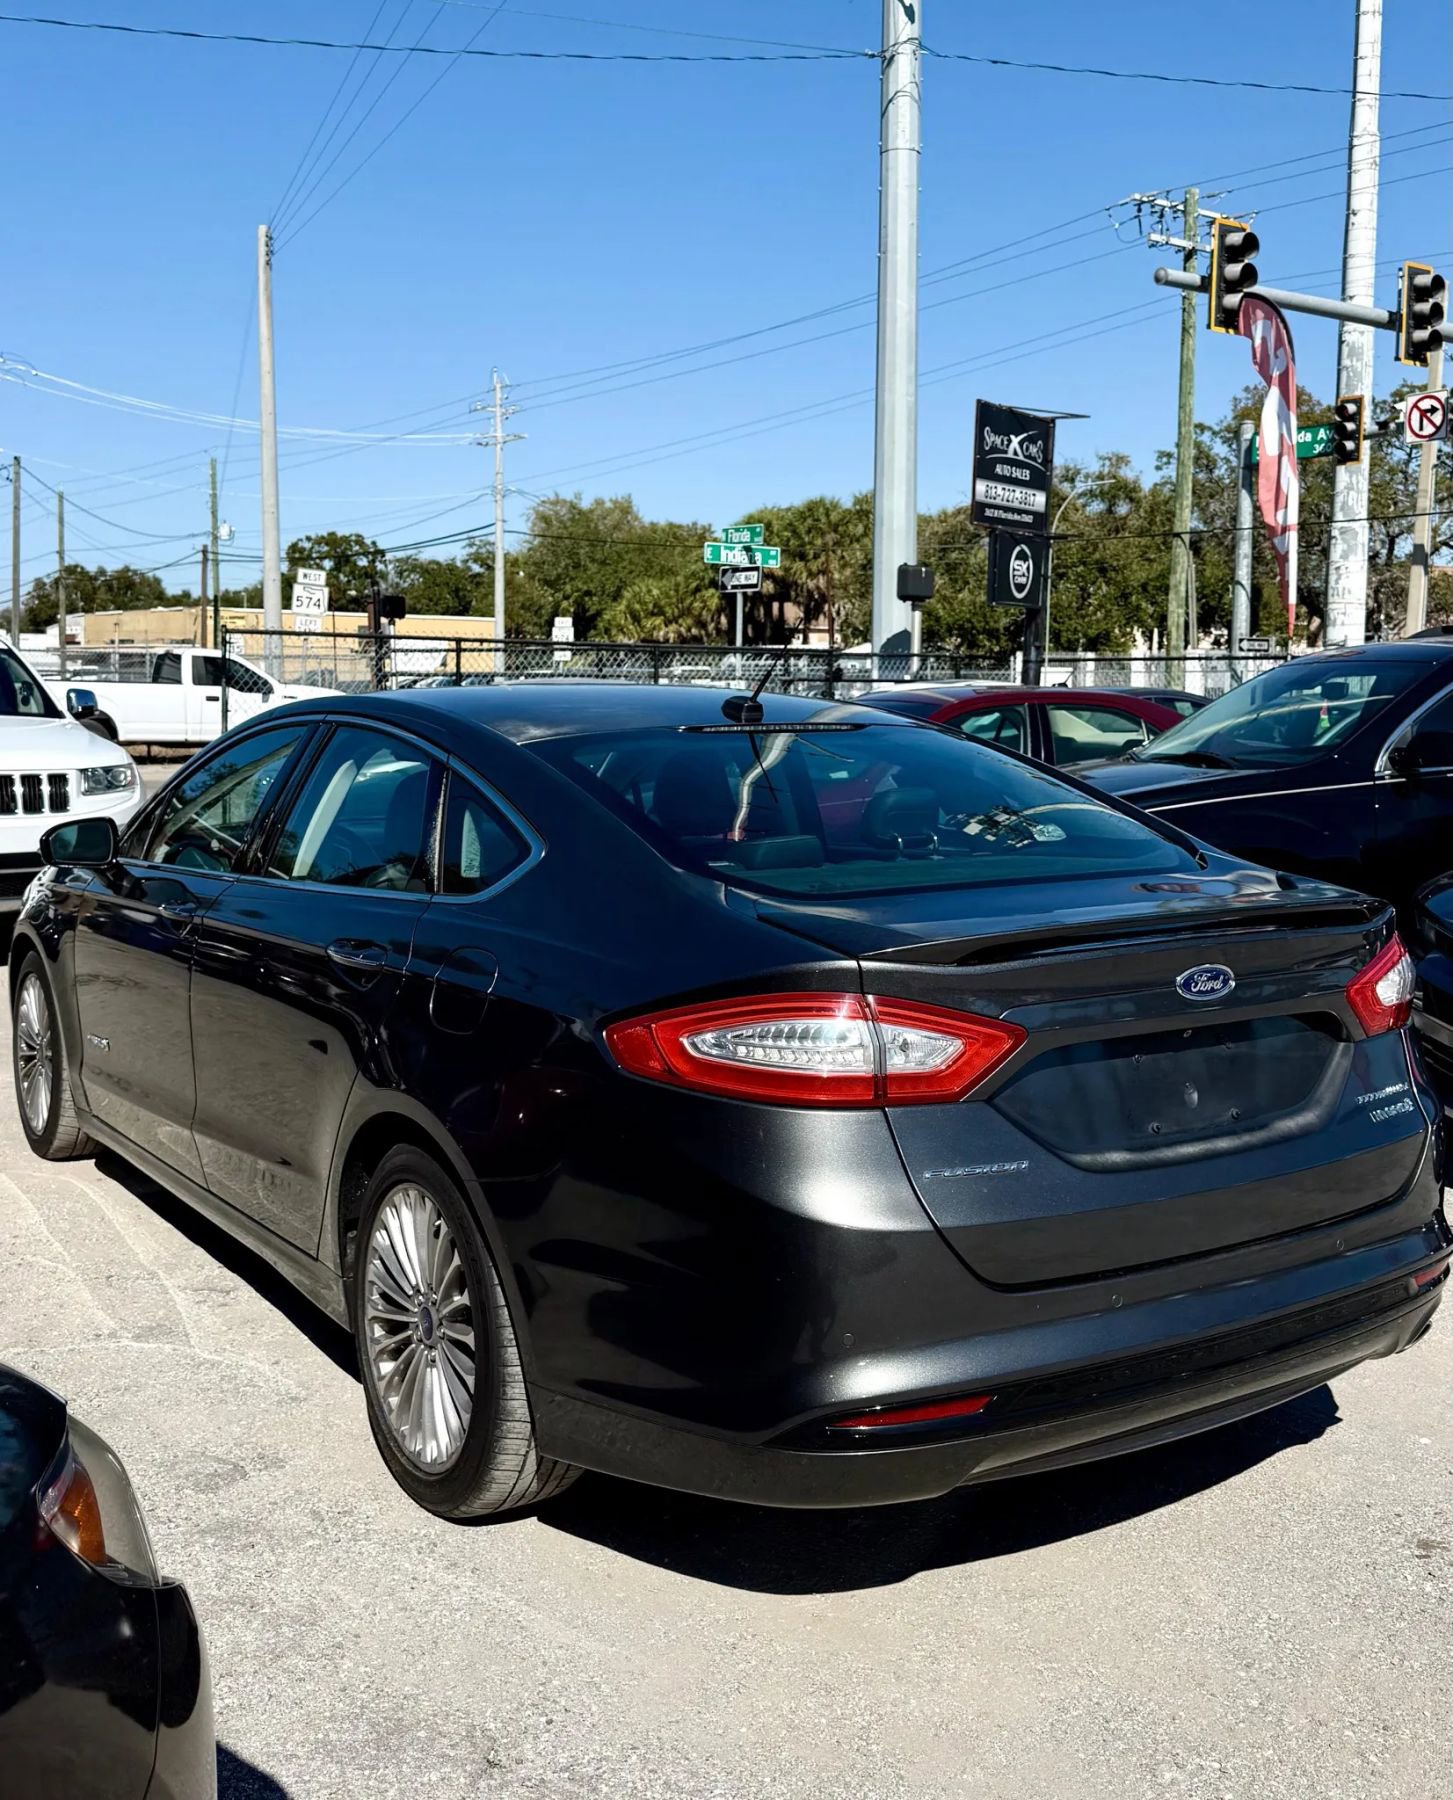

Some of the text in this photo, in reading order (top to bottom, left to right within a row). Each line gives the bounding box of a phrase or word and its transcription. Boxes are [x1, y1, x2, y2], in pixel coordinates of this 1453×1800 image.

[984, 426, 1009, 451] SPACE
[1023, 440, 1044, 463] CARS
[994, 464, 1030, 481] AUTO SALES
[984, 483, 1038, 508] 813-727-3817
[728, 529, 751, 543] Florida
[707, 546, 762, 565] E Indiana
[303, 572, 322, 581] WEST
[1013, 560, 1029, 577] SX
[744, 573, 756, 582] WAY
[296, 595, 321, 610] 574
[1190, 972, 1225, 993] Ford
